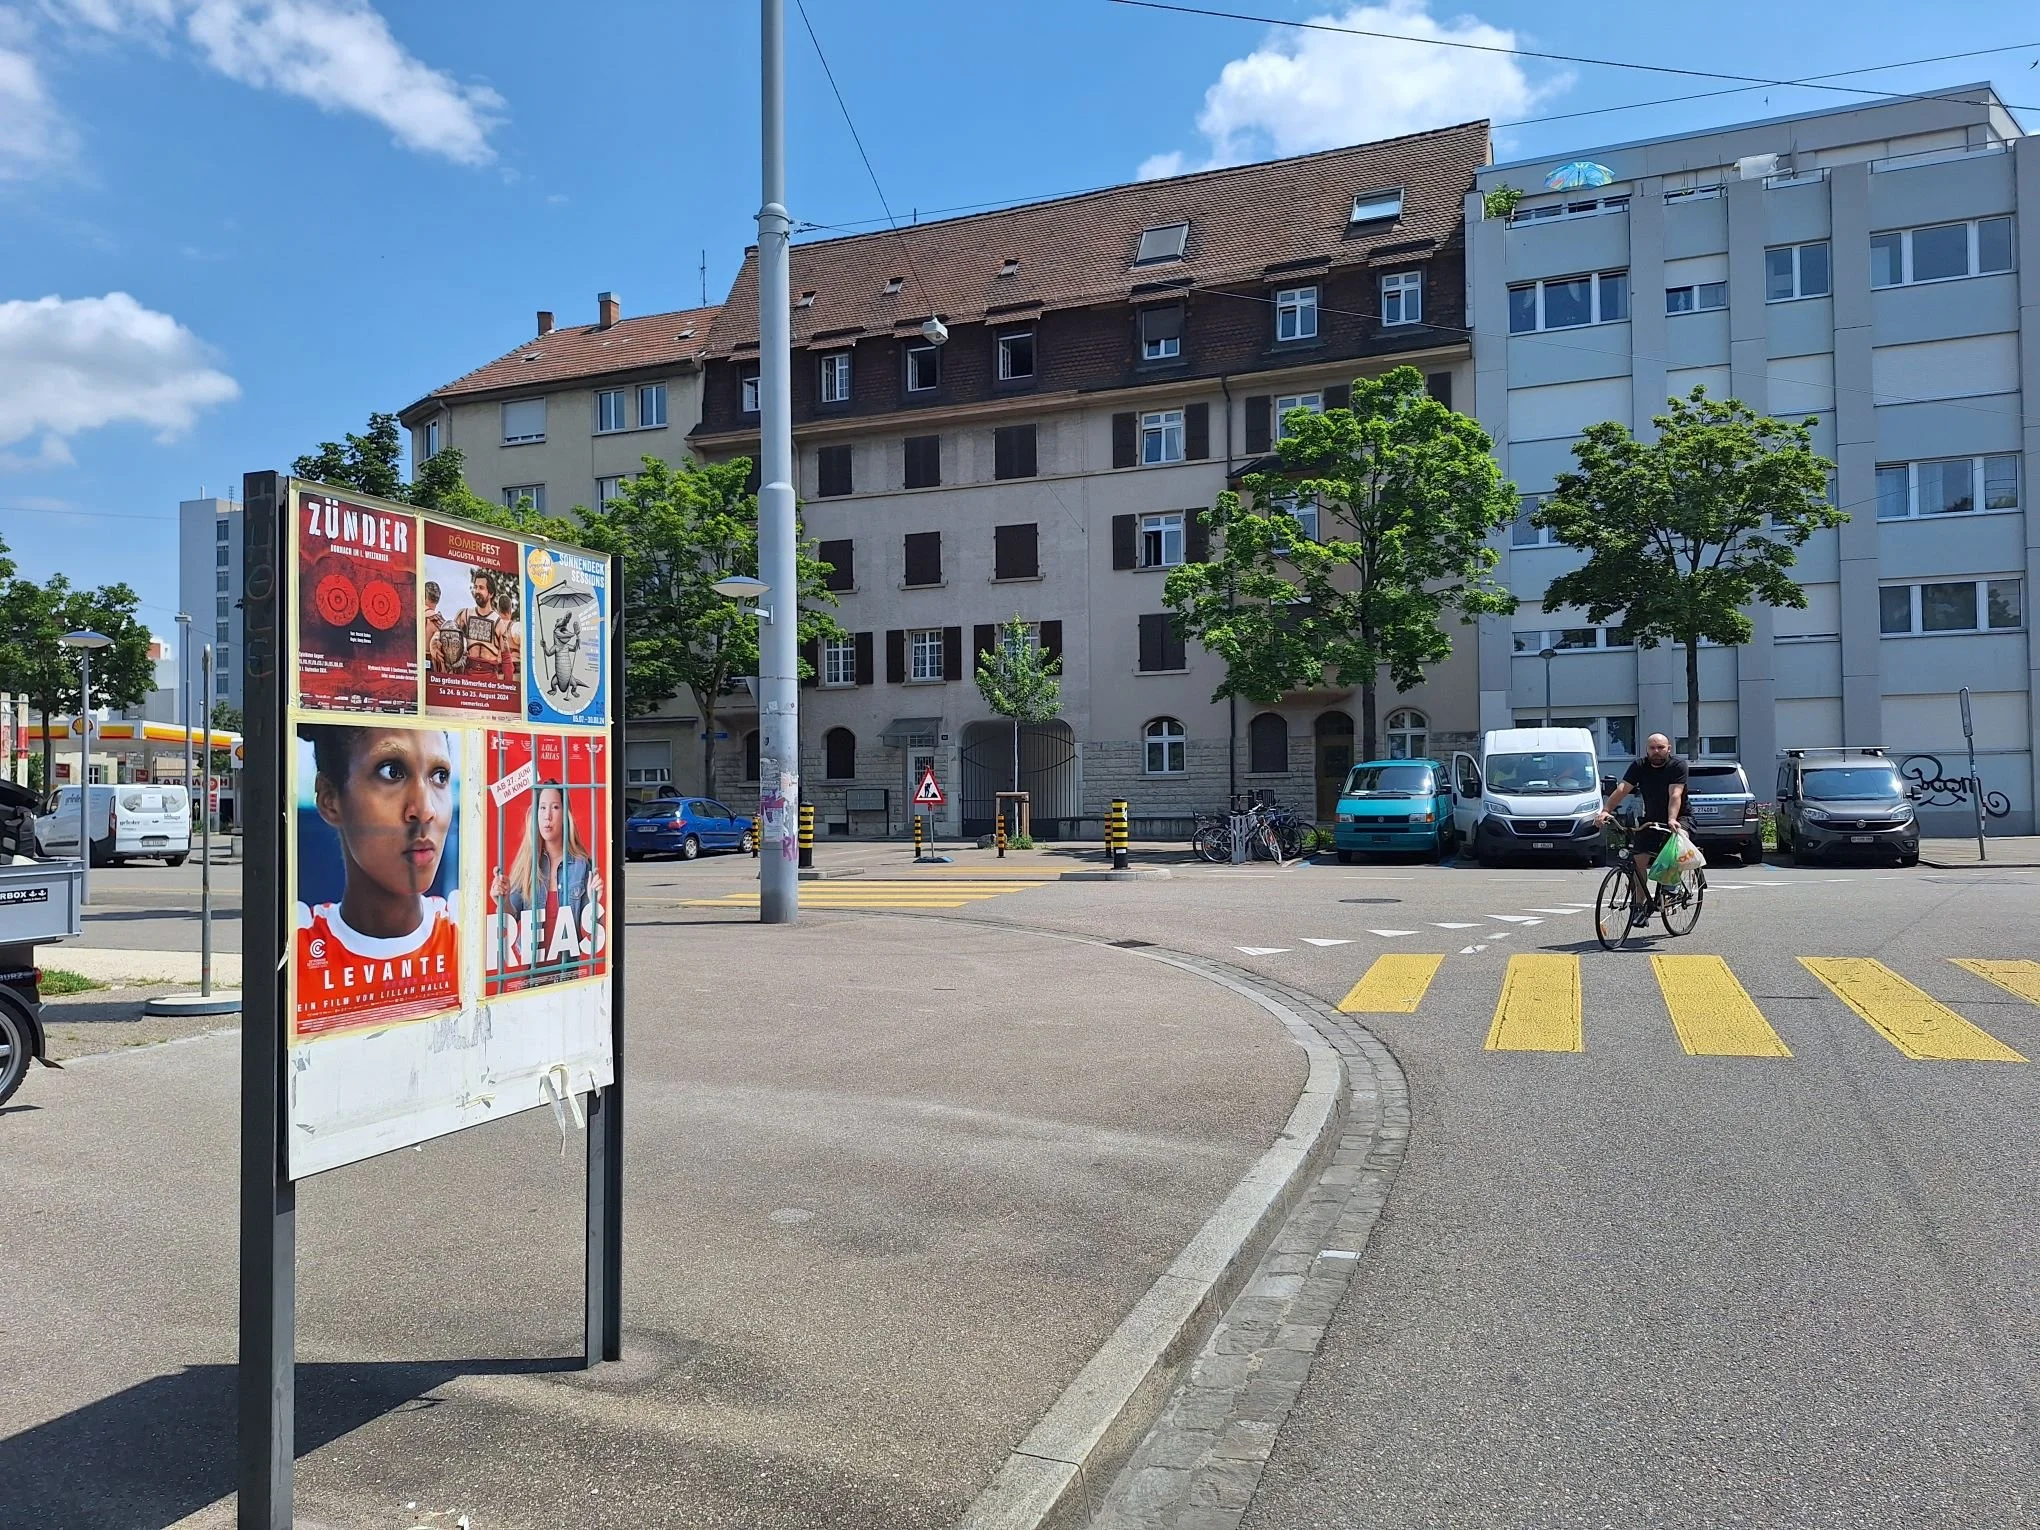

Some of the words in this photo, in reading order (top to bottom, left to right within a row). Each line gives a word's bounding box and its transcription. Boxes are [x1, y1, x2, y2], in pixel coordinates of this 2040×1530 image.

[308, 497, 408, 553] ZÜNDER
[330, 544, 352, 555] DORNACH
[365, 550, 389, 562] WELTKRIEG
[448, 534, 500, 556] RÖMERFEST
[448, 549, 475, 561] AUGUSTA
[476, 557, 501, 567] RAURICA
[560, 552, 605, 576] SONNENDECK
[571, 570, 605, 588] SESSIONS
[430, 675, 441, 683] Das
[441, 677, 461, 685] grösste
[461, 678, 487, 688] Römerfest
[496, 683, 516, 691] Schweiz
[478, 692, 496, 700] August
[496, 693, 509, 701] 2024
[541, 743, 558, 752] LOLA
[541, 752, 560, 761] ARIAS
[496, 783, 506, 793] AB
[506, 776, 516, 788] 27.
[517, 766, 531, 780] JUNI
[503, 789, 512, 799] IM
[512, 777, 530, 794] KINO!
[486, 901, 606, 971] REAS
[324, 954, 446, 990] LEVANTE
[297, 1003, 316, 1013] EIN
[323, 997, 350, 1008] FILM
[355, 993, 375, 1002] VON
[380, 987, 415, 998] LILLAH
[420, 981, 450, 993] HALLA
